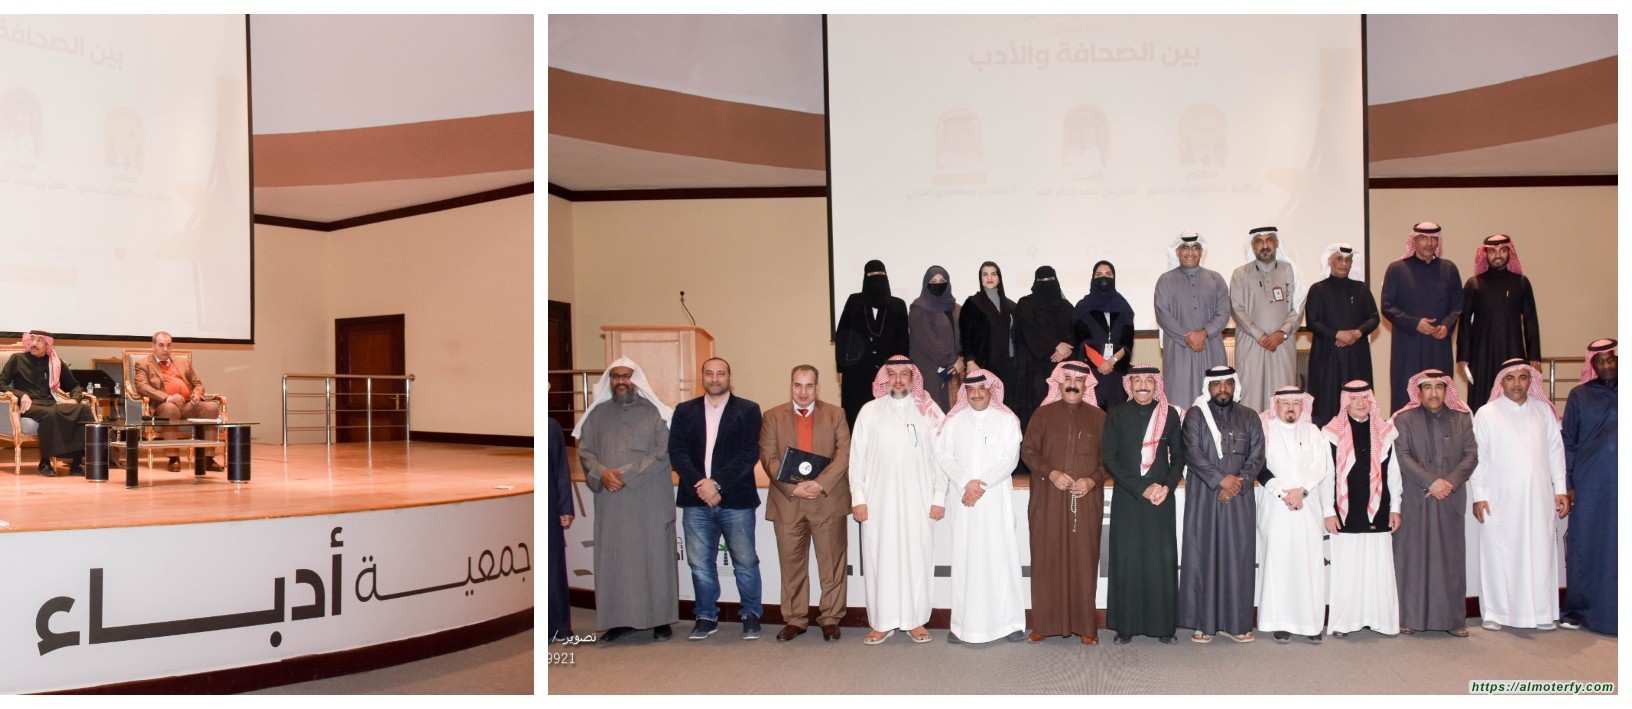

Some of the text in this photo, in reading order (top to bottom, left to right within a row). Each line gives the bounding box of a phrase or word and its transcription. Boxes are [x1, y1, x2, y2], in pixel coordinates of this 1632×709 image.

[968, 41, 1201, 72] بين الصحافة والأدب
[35, 526, 344, 657] أدباء
[355, 542, 532, 603] جمعية
